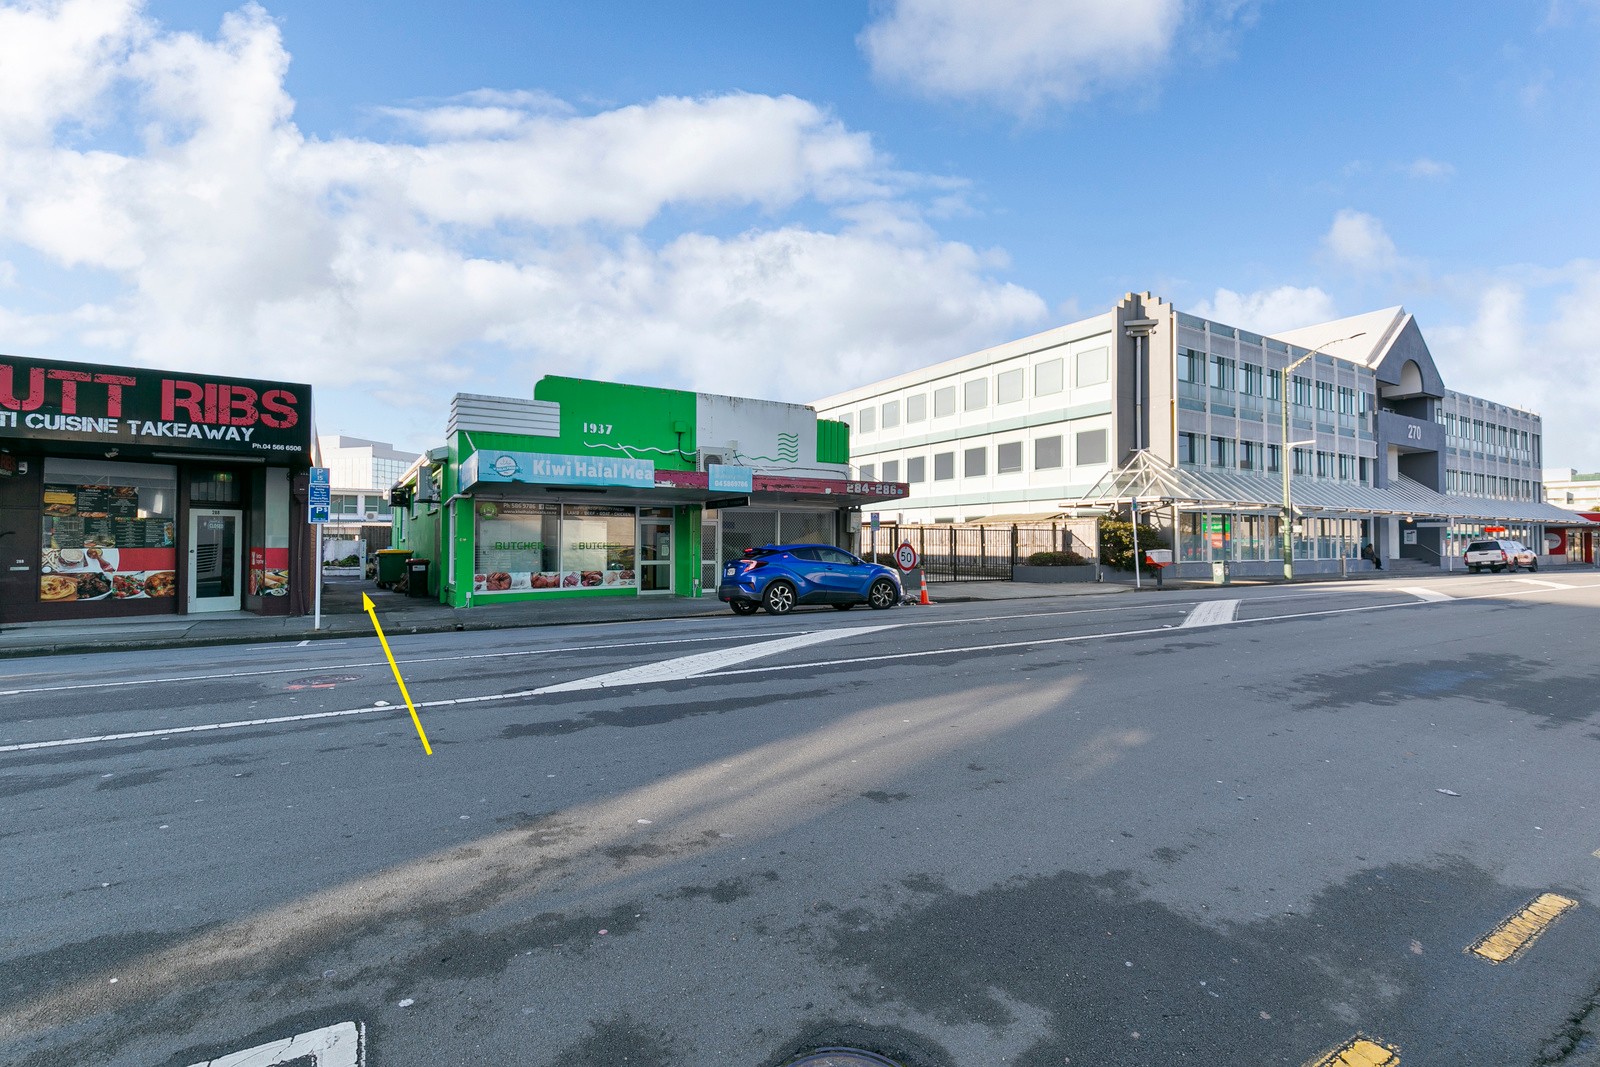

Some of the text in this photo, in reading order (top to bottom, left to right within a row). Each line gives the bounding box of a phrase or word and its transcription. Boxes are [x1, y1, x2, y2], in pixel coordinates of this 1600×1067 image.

[161, 379, 299, 429] RIBS
[25, 413, 118, 434] CUISINE
[127, 420, 254, 442] TAKEAWAY
[583, 422, 613, 435] 1937
[1408, 424, 1422, 440] 270
[252, 442, 271, 450] Ph.04
[533, 460, 653, 481] Kiwi Halal Mea
[846, 482, 897, 495] 284-286
[495, 541, 545, 550] BUTCHER
[578, 541, 621, 550] BUTCHER
[900, 551, 912, 563] 50
